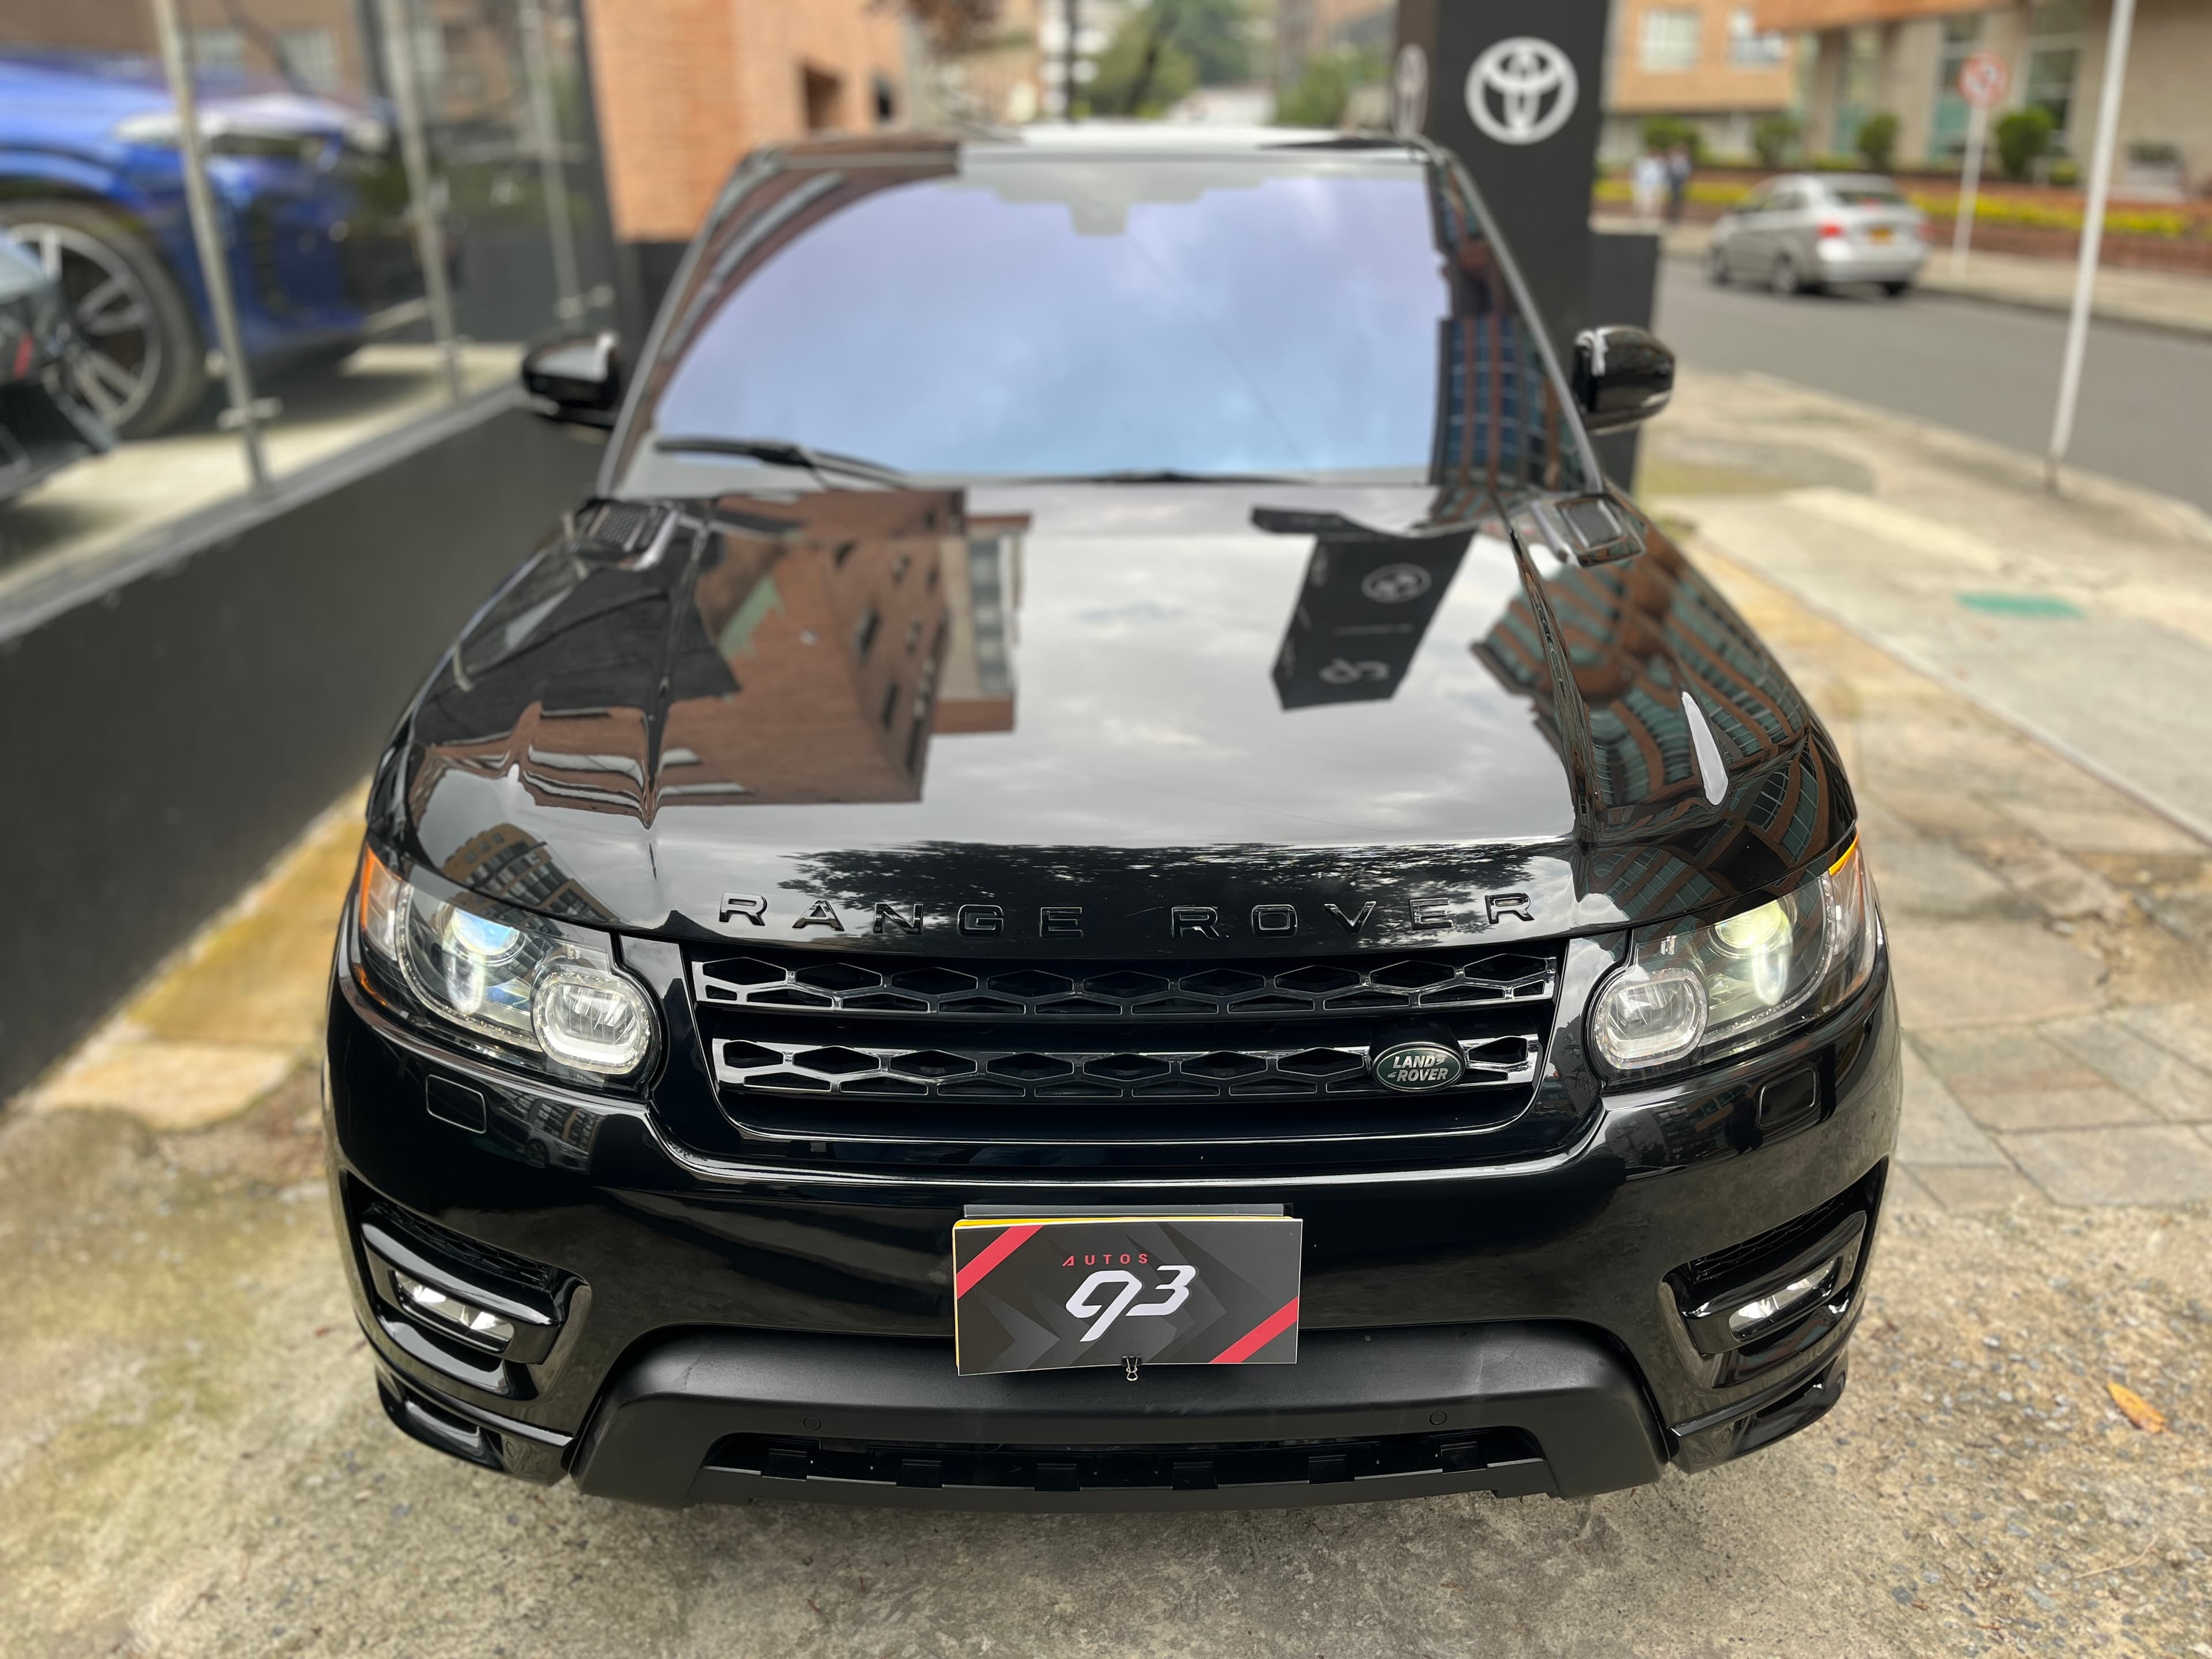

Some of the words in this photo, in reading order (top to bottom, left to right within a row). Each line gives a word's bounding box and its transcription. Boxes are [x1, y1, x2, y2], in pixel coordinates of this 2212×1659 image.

[719, 891, 1084, 938] RANGE
[1171, 892, 1535, 939] ROVER
[1393, 1055, 1435, 1068] LAND
[1396, 1068, 1448, 1082] ROVER
[1062, 1253, 1148, 1267] AUTOS
[1066, 1265, 1196, 1342] 93
